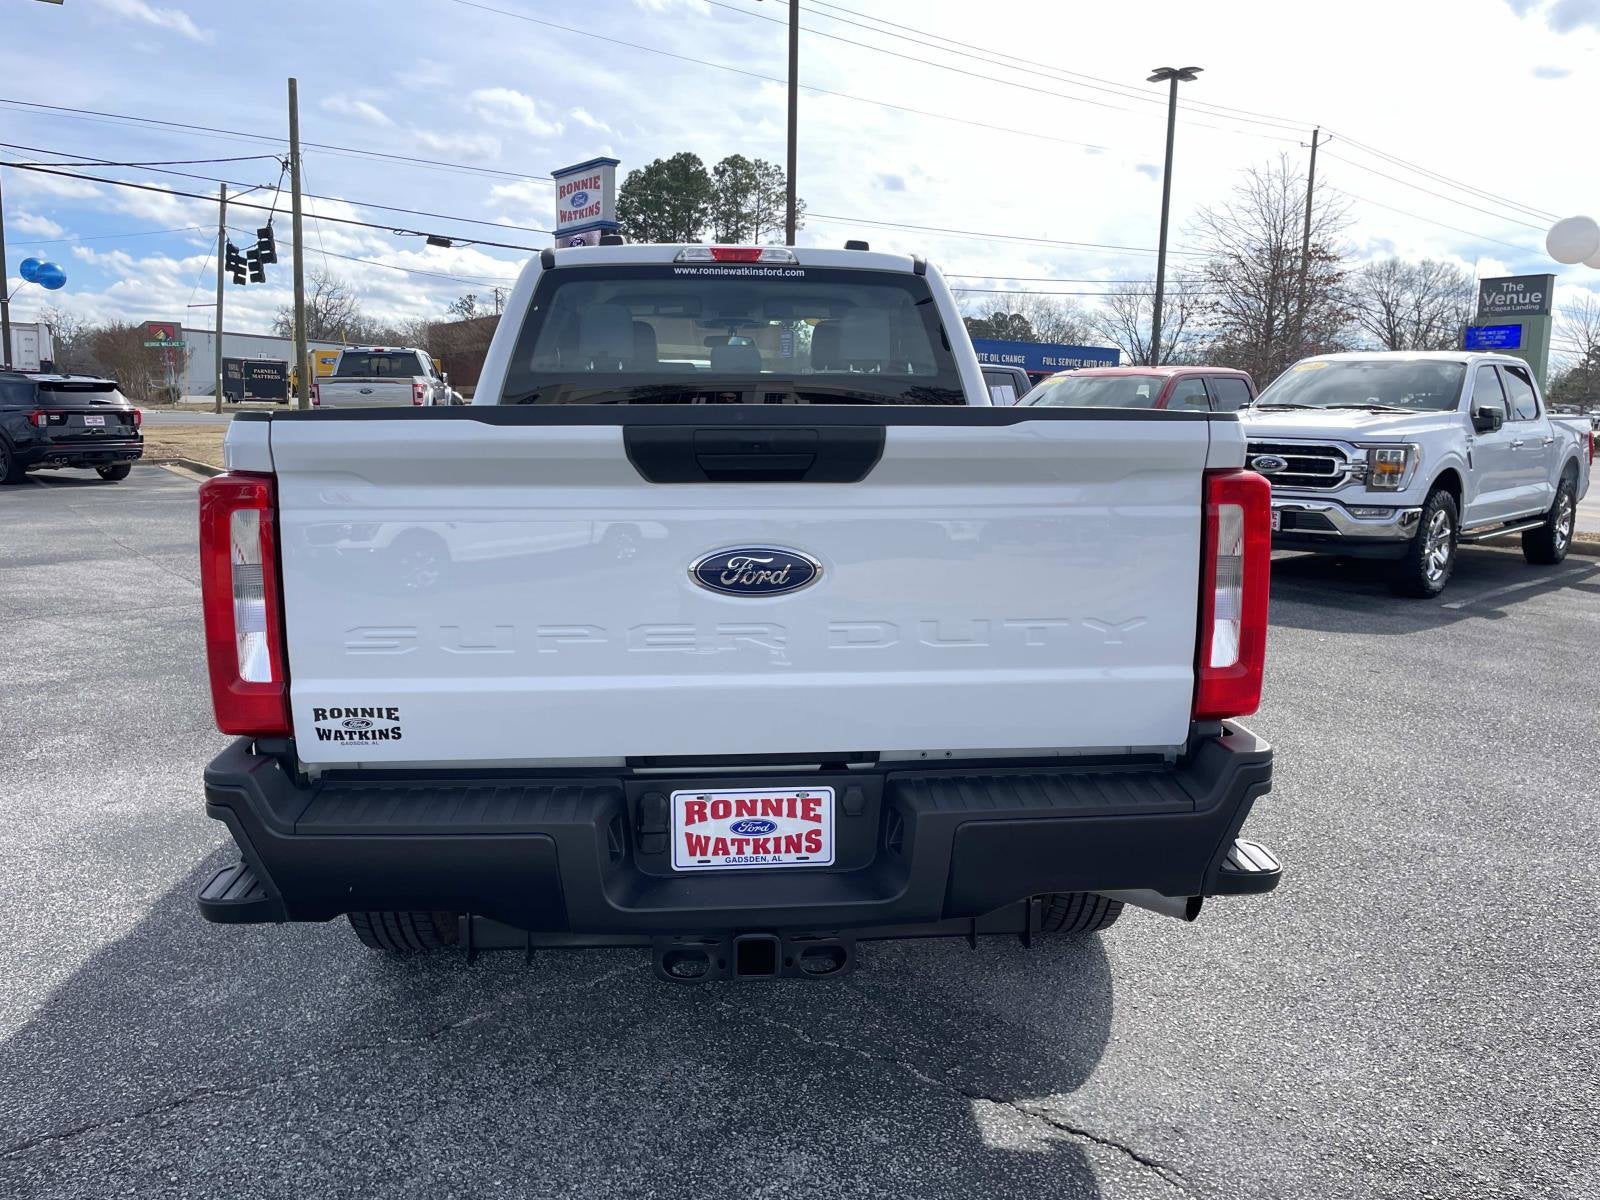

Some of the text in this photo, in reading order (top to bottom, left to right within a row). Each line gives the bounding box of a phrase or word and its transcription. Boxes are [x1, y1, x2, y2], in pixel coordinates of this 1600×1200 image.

[560, 175, 601, 199] RONNIE
[560, 201, 601, 223] WATKINS
[674, 267, 805, 277] www.ronniewatkinsford.com
[1501, 282, 1525, 292] The
[1483, 292, 1542, 306] Venue
[1512, 303, 1540, 311] Landing
[990, 354, 1000, 363] OIL
[1001, 354, 1026, 364] CHANGE
[1042, 357, 1057, 366] FULL
[1058, 358, 1081, 367] SERVICE
[1083, 359, 1098, 368] AUTO
[720, 556, 792, 585] Ford
[344, 616, 1147, 655] SUPER DUTY
[312, 707, 400, 722] RONNIE
[314, 726, 402, 741] WATKINS
[684, 797, 822, 826] RONNIE
[738, 821, 771, 832] Ford
[684, 829, 823, 857] WATKINS
[725, 856, 769, 864] GADSDEN,
